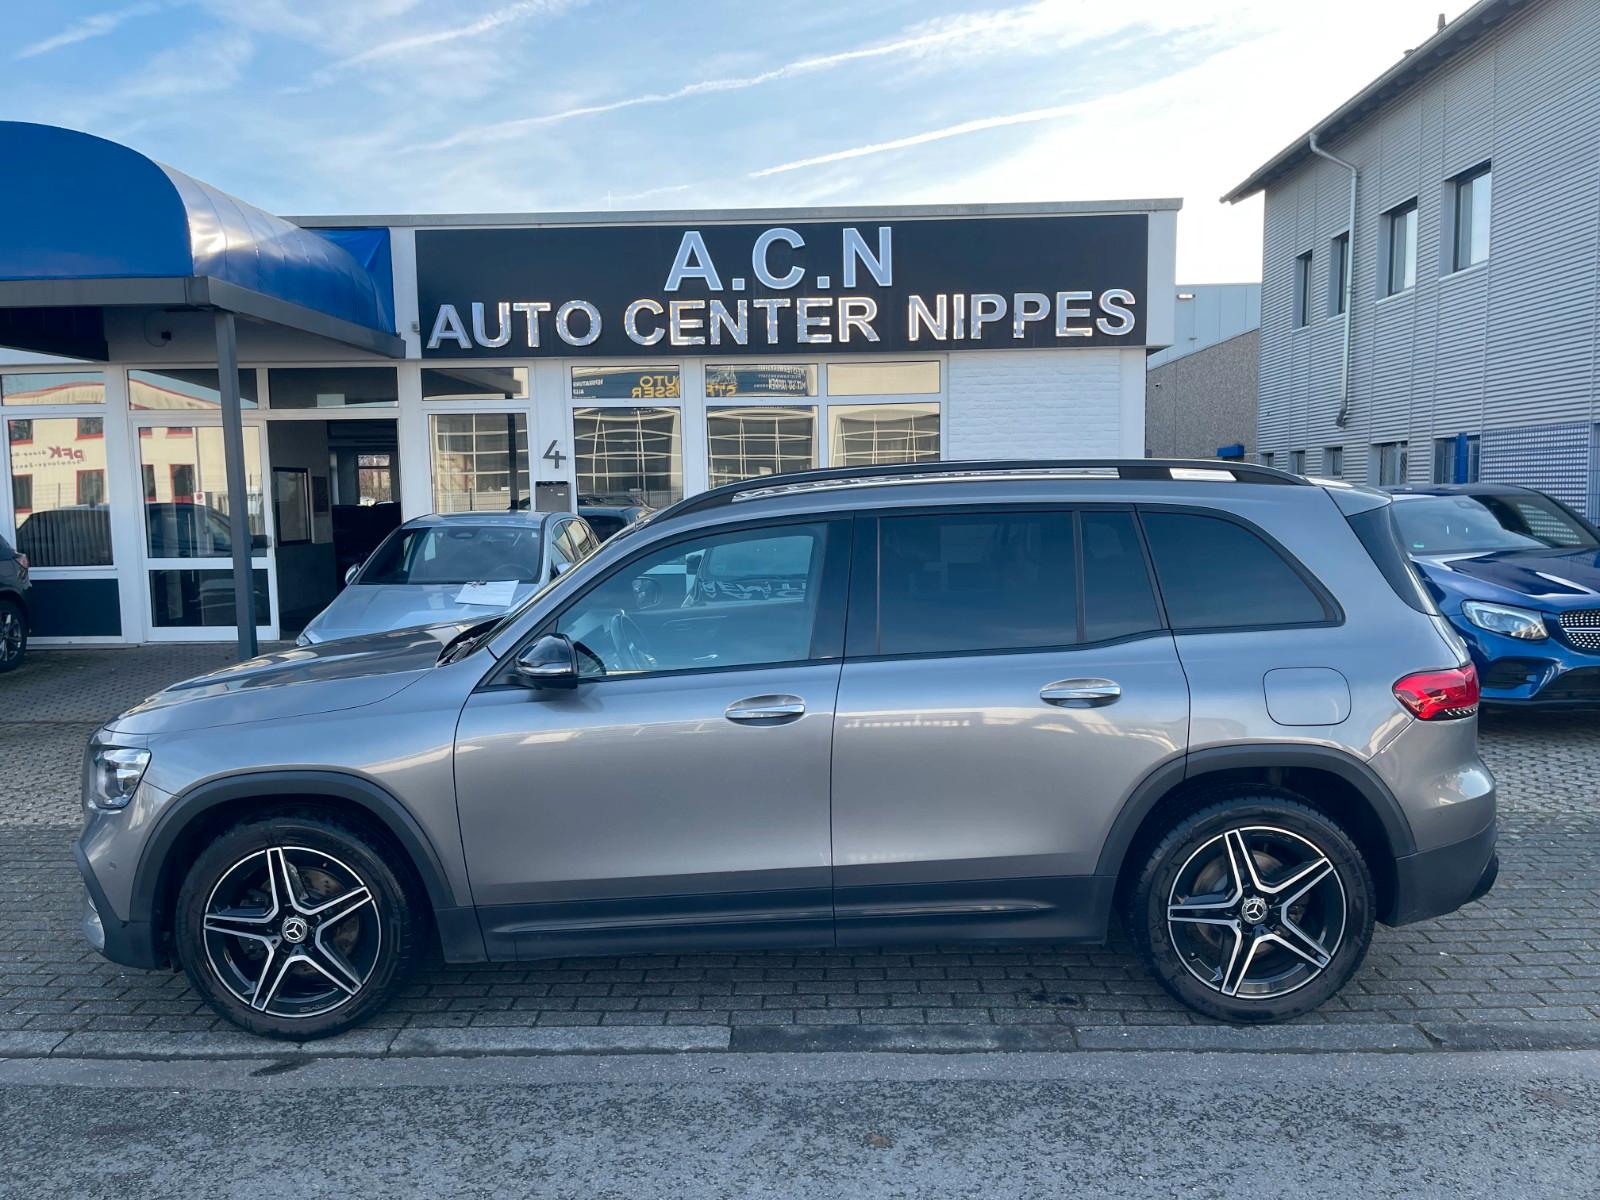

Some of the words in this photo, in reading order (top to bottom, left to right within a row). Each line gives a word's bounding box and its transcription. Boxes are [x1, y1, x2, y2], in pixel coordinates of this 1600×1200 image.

[664, 226, 893, 292] A.C.N
[426, 299, 602, 349] AUTO
[624, 296, 881, 346] CENTER
[908, 288, 1136, 342] NIPPES
[543, 439, 567, 469] 4
